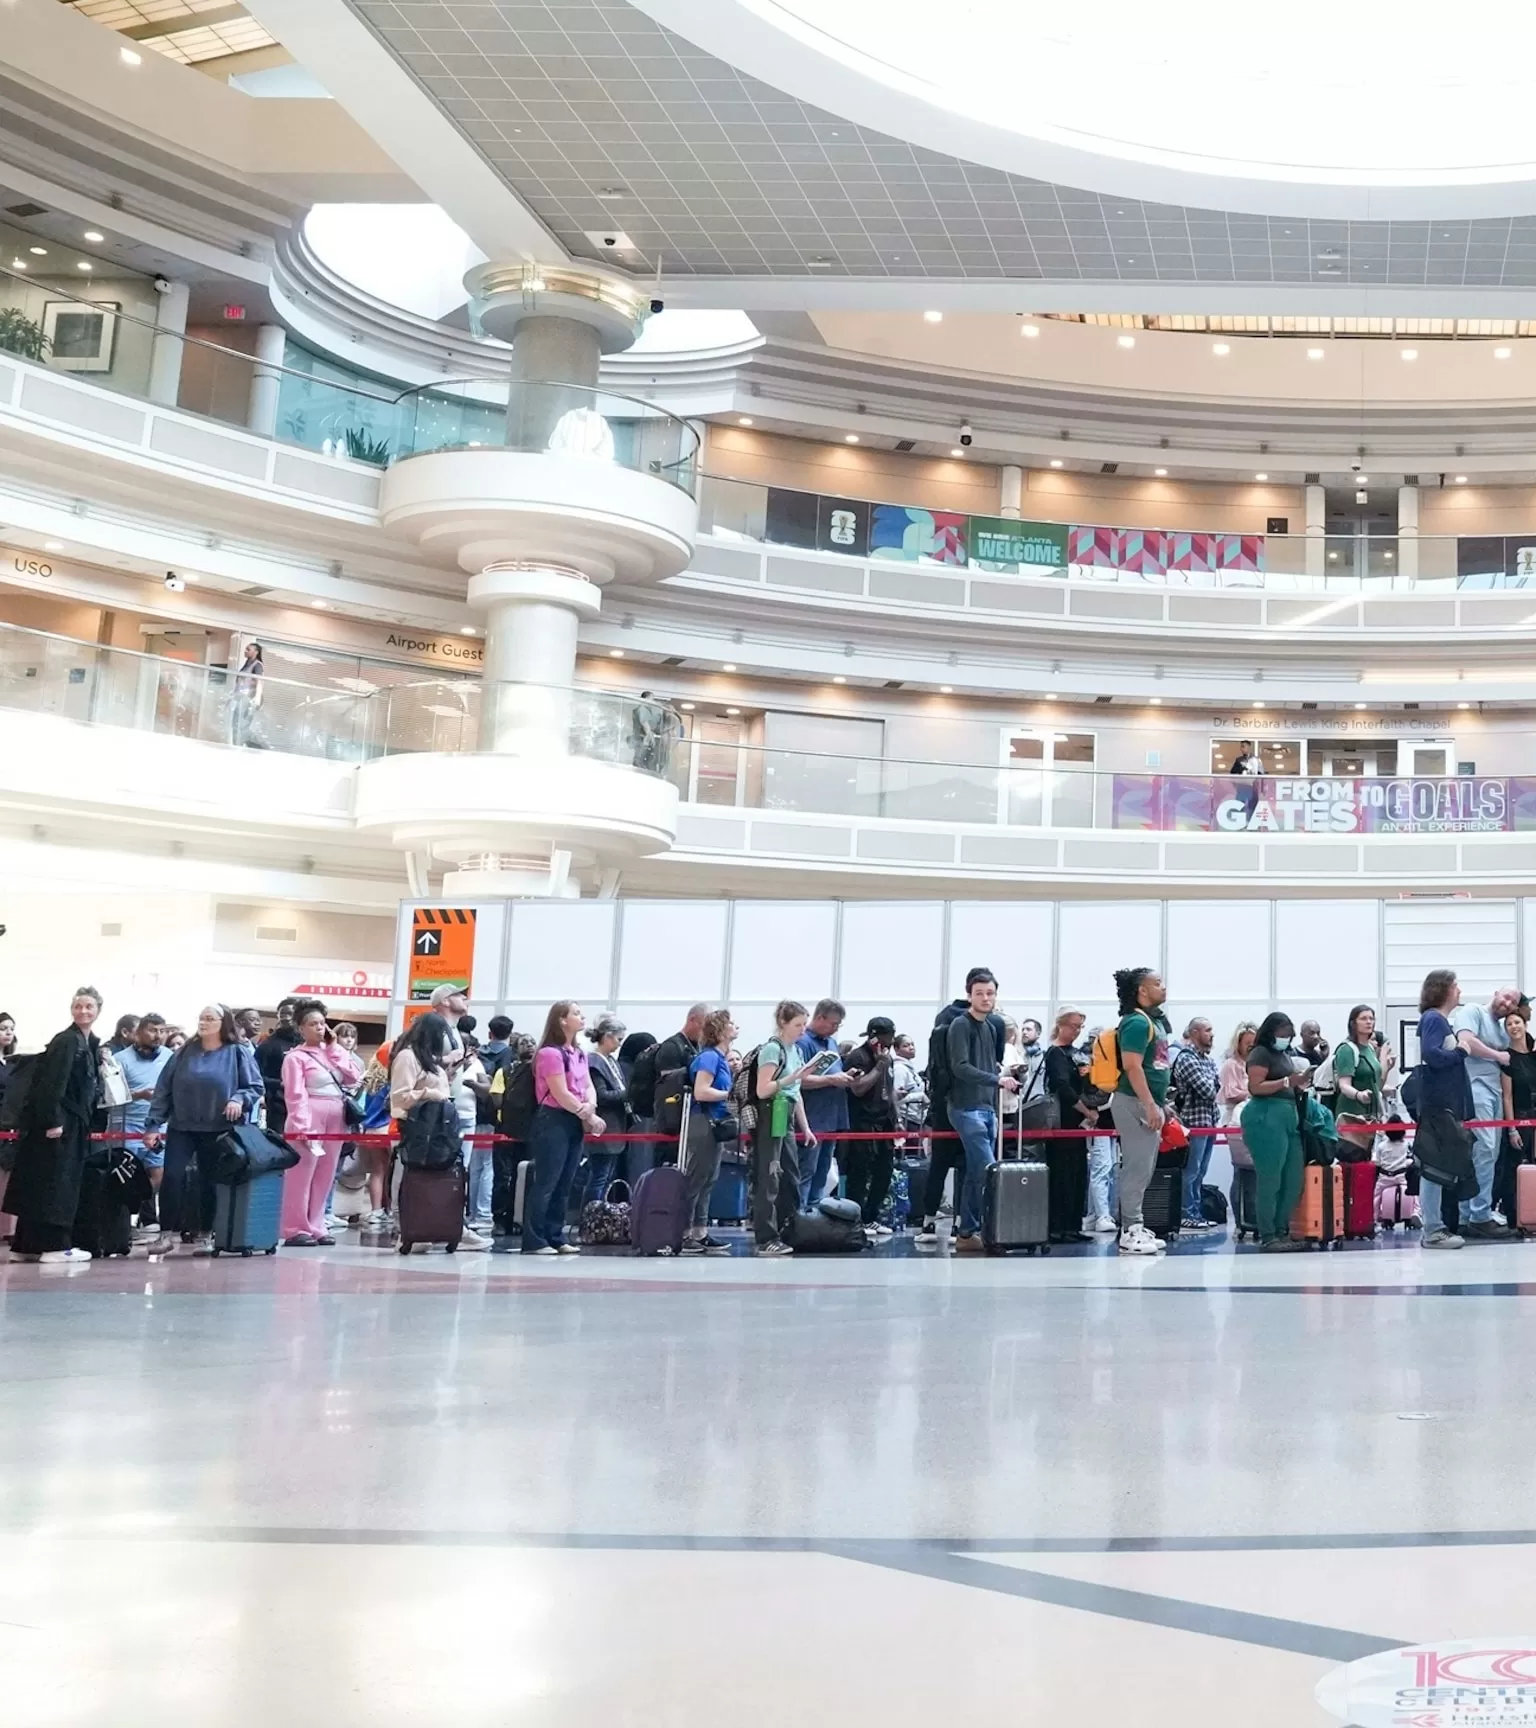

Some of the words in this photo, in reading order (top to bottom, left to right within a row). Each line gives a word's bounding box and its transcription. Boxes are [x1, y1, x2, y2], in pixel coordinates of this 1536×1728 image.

[978, 538, 1061, 564] WELCOME
[1011, 535, 1053, 545] ATLANTA
[15, 557, 53, 578] USO
[386, 634, 438, 654] Airport
[442, 643, 485, 661] Guest
[1233, 717, 1281, 729] Barbara
[1284, 718, 1317, 729] Lewis
[1321, 719, 1349, 731] King
[1352, 719, 1406, 730] Interfaith
[1409, 719, 1451, 730] Chapel
[1275, 780, 1355, 801] FROM
[1359, 785, 1384, 808] TO
[1385, 780, 1506, 821] GOALS
[1216, 799, 1358, 832] GATES
[1381, 821, 1400, 832] AN
[1403, 821, 1426, 832] ATL
[1428, 820, 1504, 832] EXPERIENCE
